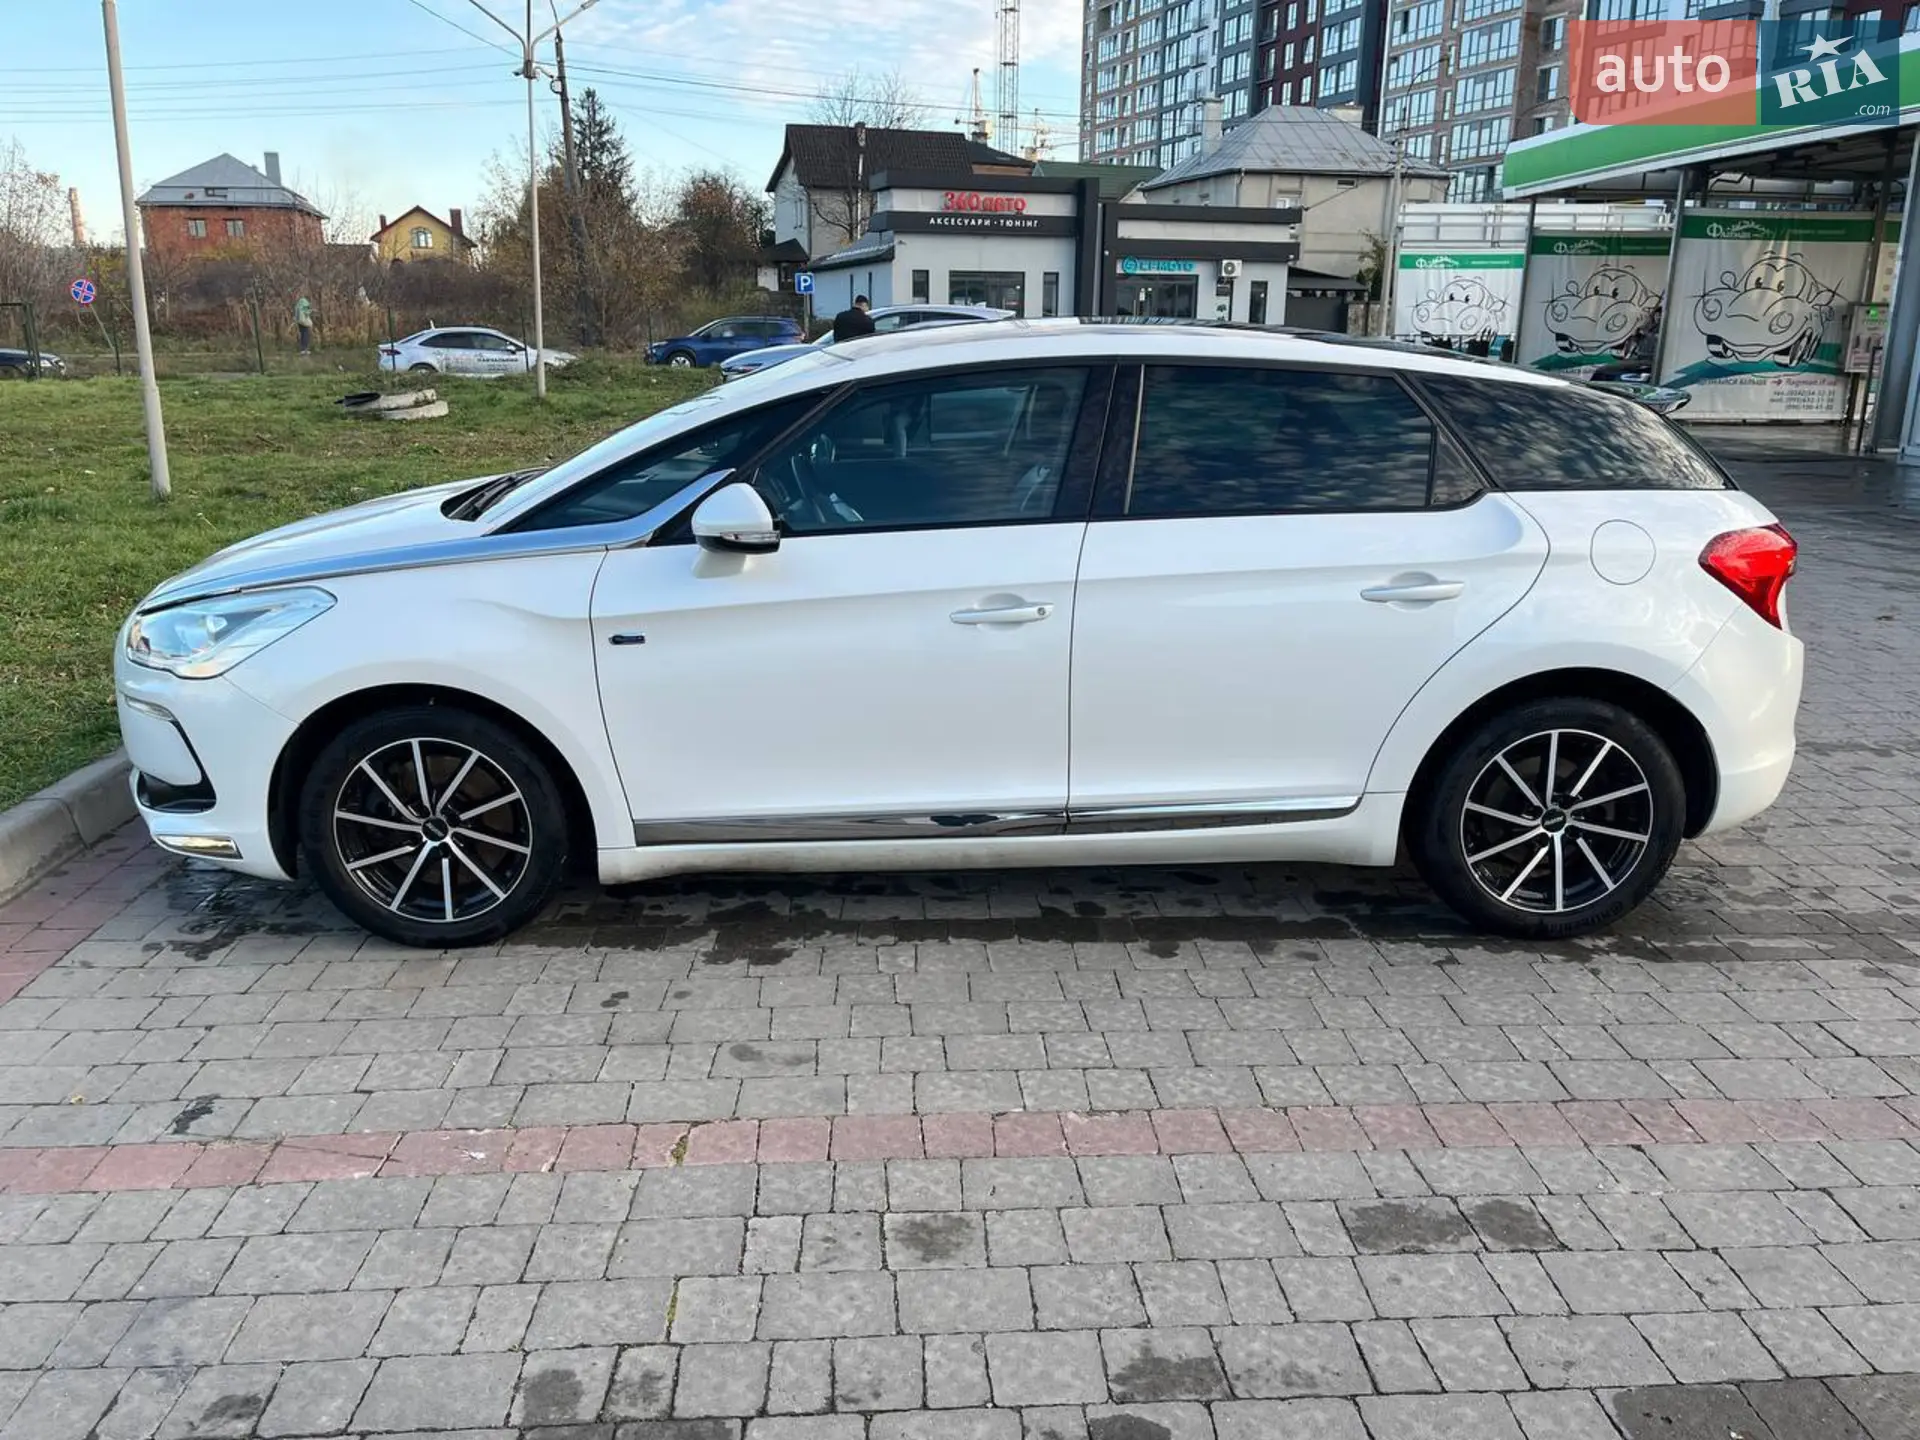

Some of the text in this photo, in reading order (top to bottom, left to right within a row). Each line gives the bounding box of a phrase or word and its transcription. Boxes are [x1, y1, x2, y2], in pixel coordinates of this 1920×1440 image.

[929, 217, 1039, 228] АКСЕСУАРИ ТЮНІНГ
[800, 275, 811, 291] P
